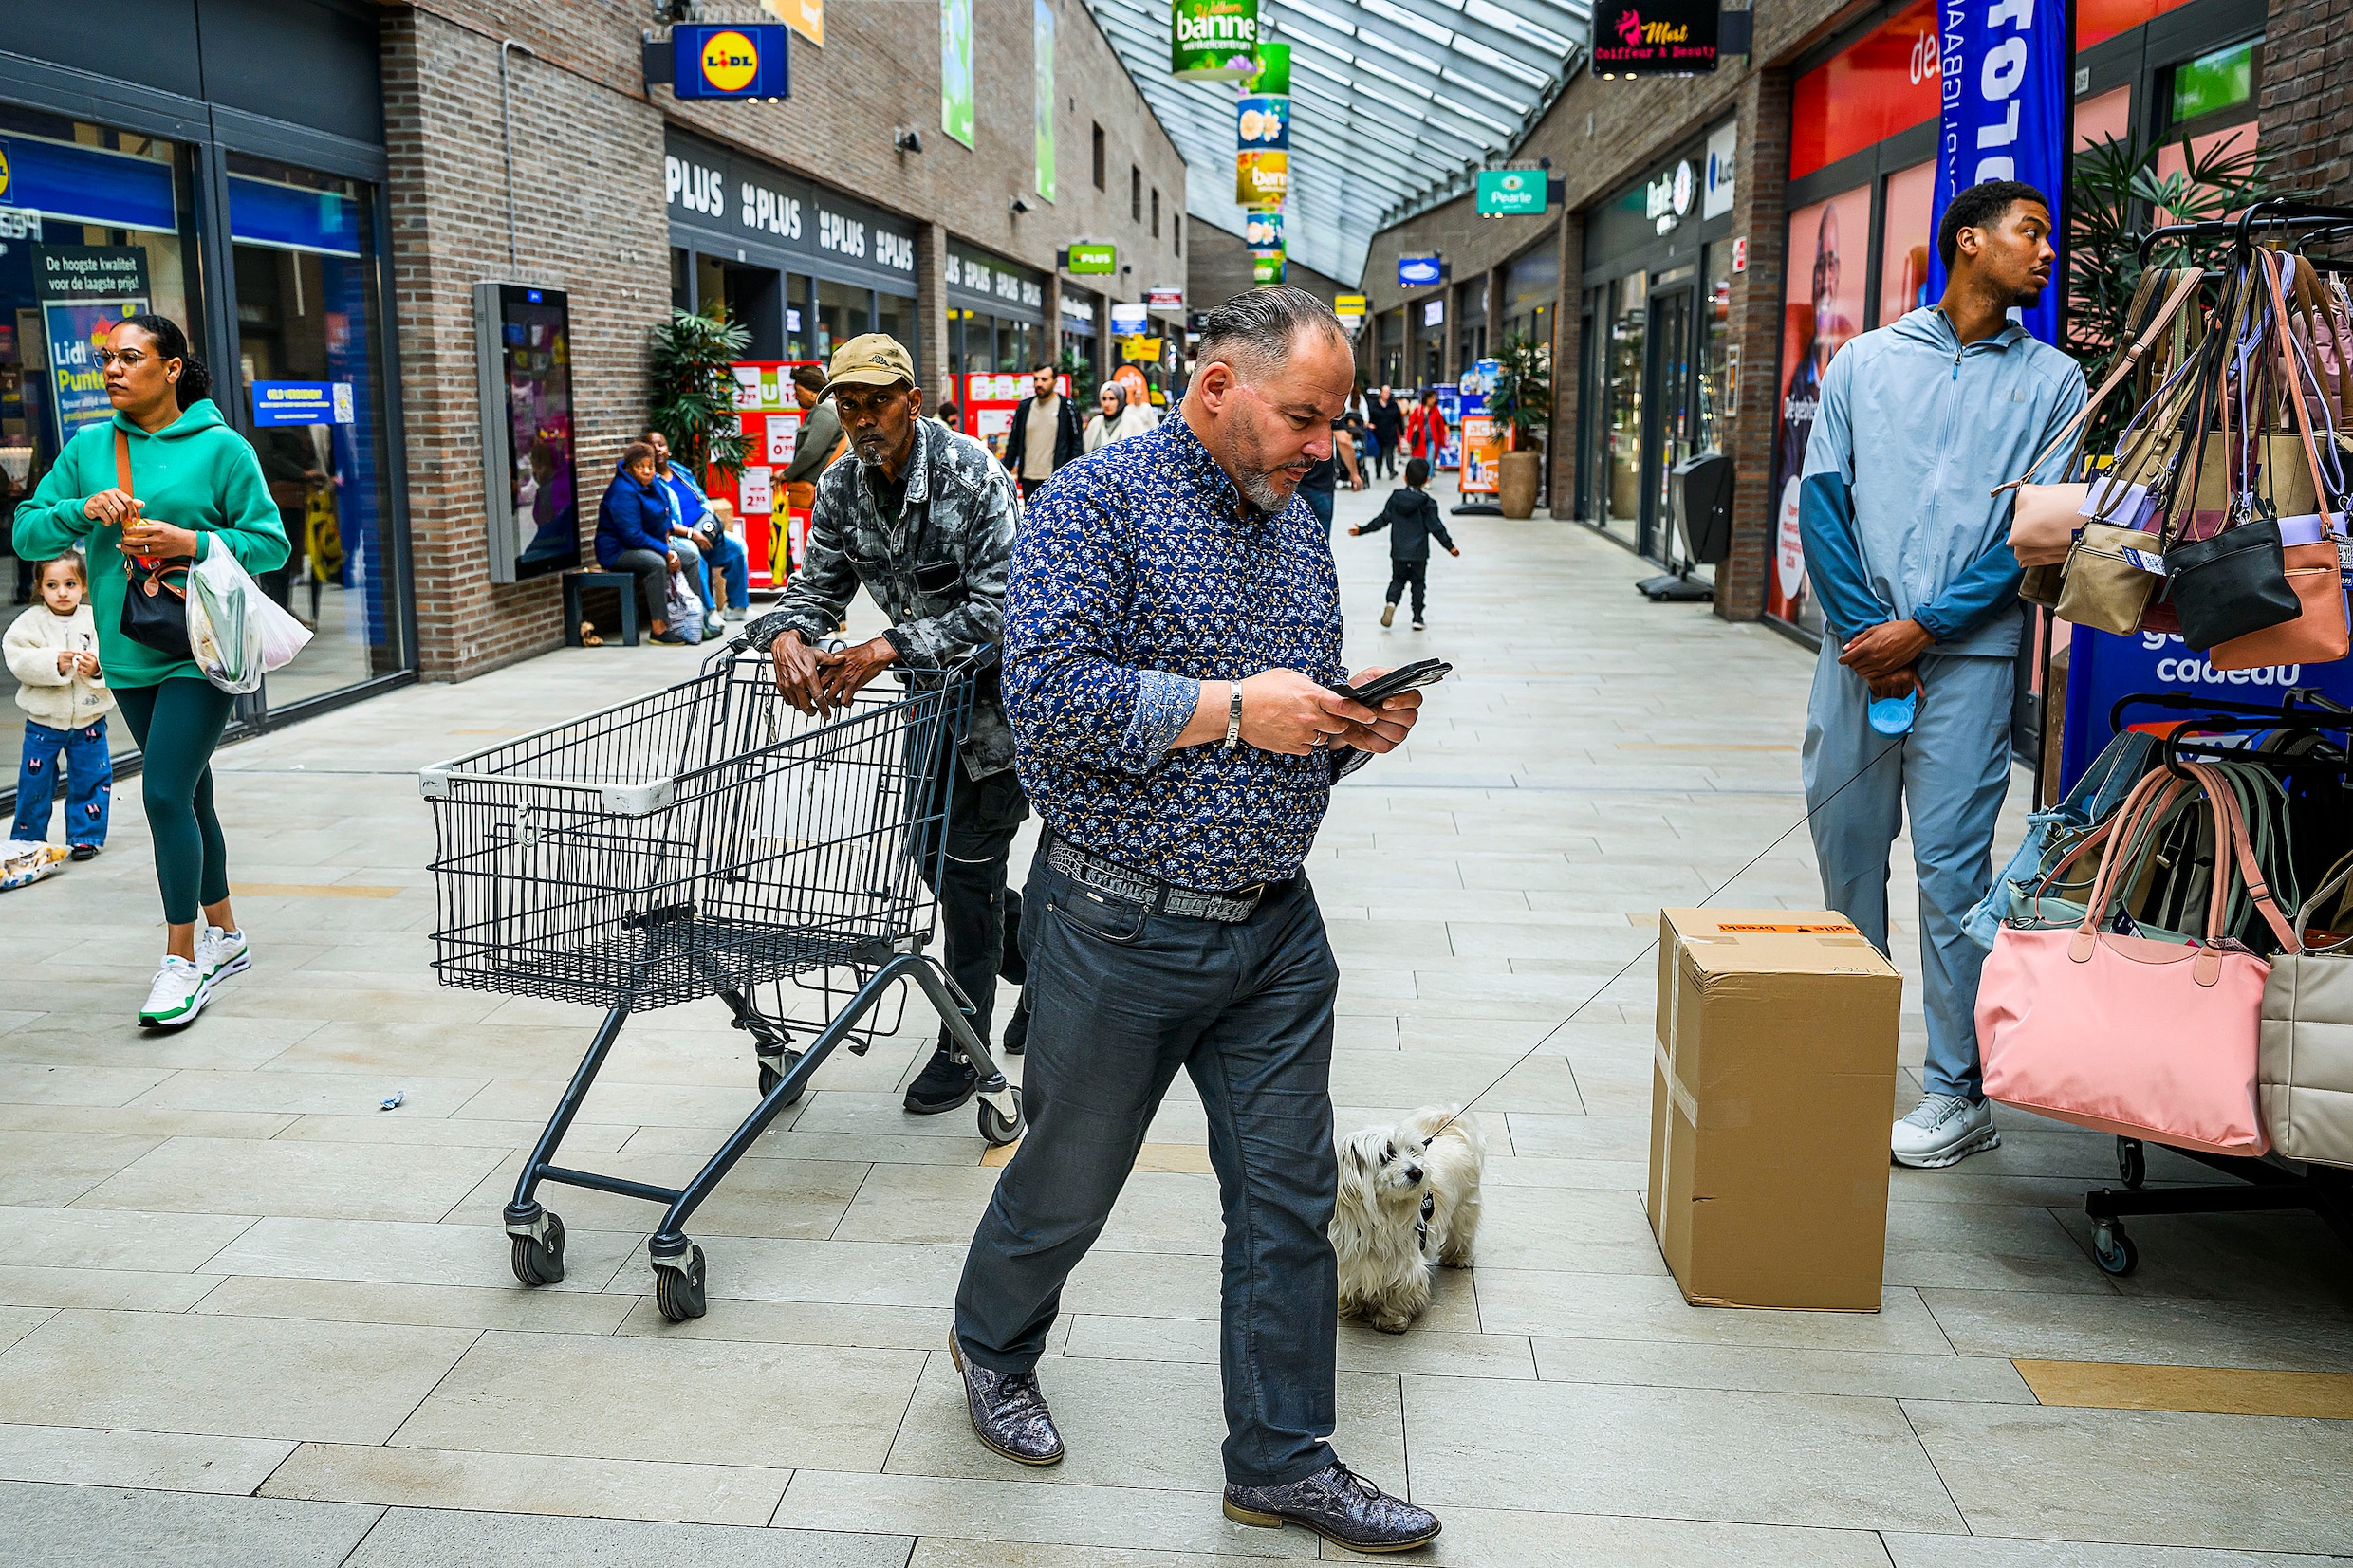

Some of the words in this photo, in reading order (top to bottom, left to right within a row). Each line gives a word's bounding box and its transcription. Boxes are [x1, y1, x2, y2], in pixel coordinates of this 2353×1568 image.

[1177, 10, 1255, 41] banne
[1596, 46, 1654, 59] Coiffeur
[1672, 46, 1716, 59] Beauty
[1910, 28, 1940, 85] de
[665, 155, 725, 218] PLUS
[1491, 191, 1532, 204] Pearle
[756, 187, 803, 241] PLUS
[830, 214, 867, 259] PLUS
[46, 256, 60, 271] De
[62, 256, 97, 274] hoogste
[100, 256, 137, 271] kwaliteit
[885, 231, 914, 272] PLUS
[1081, 253, 1111, 264] PLUS
[49, 278, 70, 290] voor
[71, 276, 83, 290] de
[84, 276, 116, 293] laagste
[118, 275, 139, 292] prijs!
[54, 340, 87, 366] Lidl
